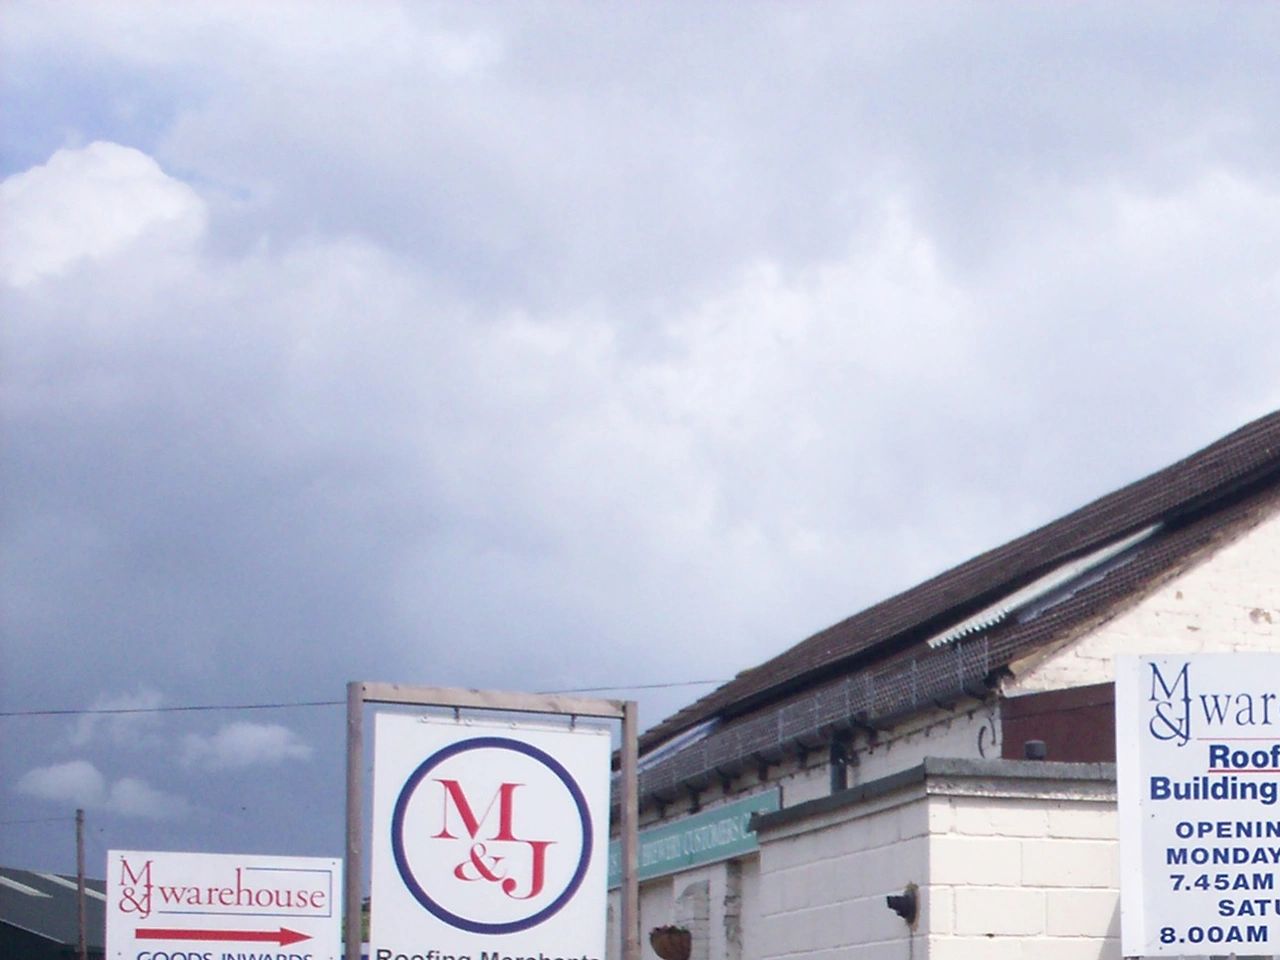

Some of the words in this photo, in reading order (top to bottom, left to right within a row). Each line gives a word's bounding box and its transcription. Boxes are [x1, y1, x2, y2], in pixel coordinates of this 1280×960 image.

[1150, 776, 1279, 805] Building
[159, 866, 327, 909] warehouse
[1169, 872, 1275, 892] 7.45AM
[1159, 925, 1270, 945] 8.00AM
